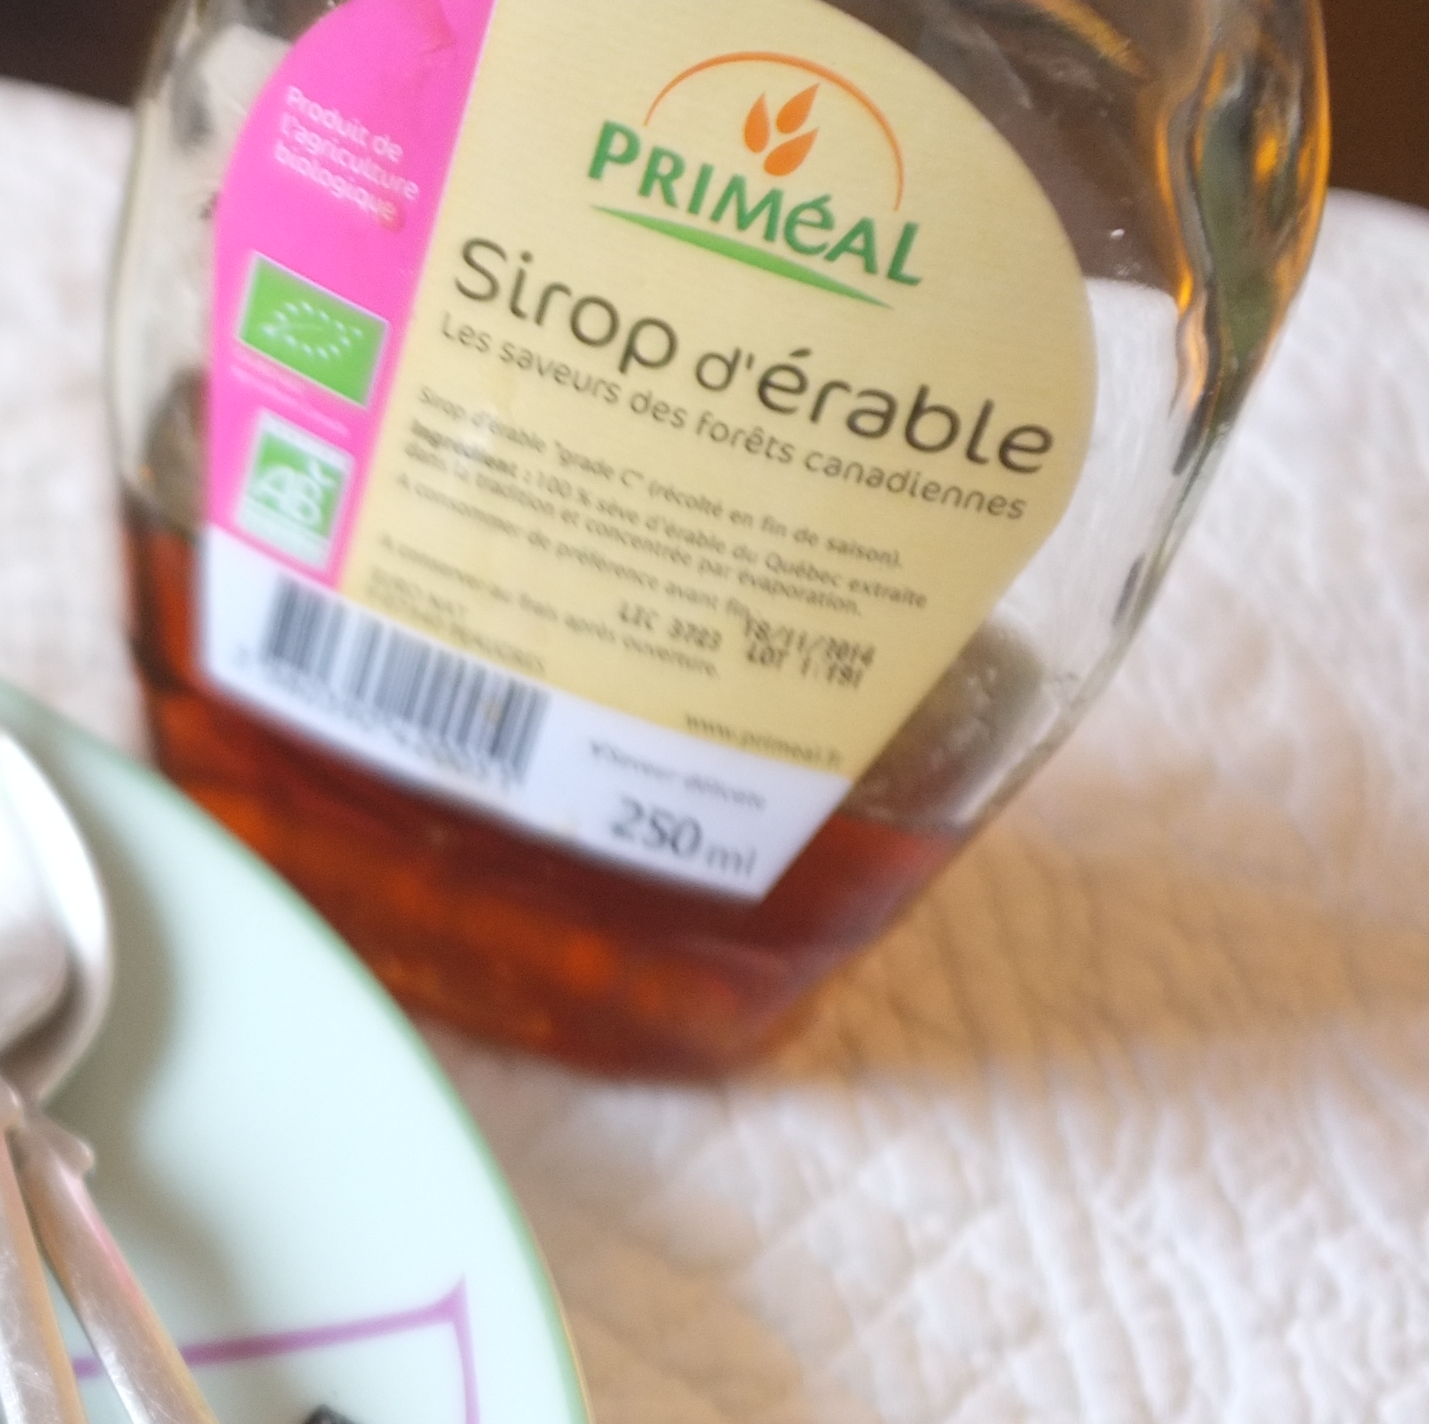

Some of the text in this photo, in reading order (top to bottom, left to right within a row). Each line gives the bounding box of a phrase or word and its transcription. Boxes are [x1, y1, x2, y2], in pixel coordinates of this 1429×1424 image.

[372, 134, 404, 163] de
[454, 237, 1055, 475] Sirop d'érable
[441, 310, 1027, 520] Les saveurs des forêts canadiennes
[729, 509, 754, 527] en
[761, 514, 787, 537] fin
[793, 527, 819, 547] de
[611, 793, 757, 882] 250 ml
